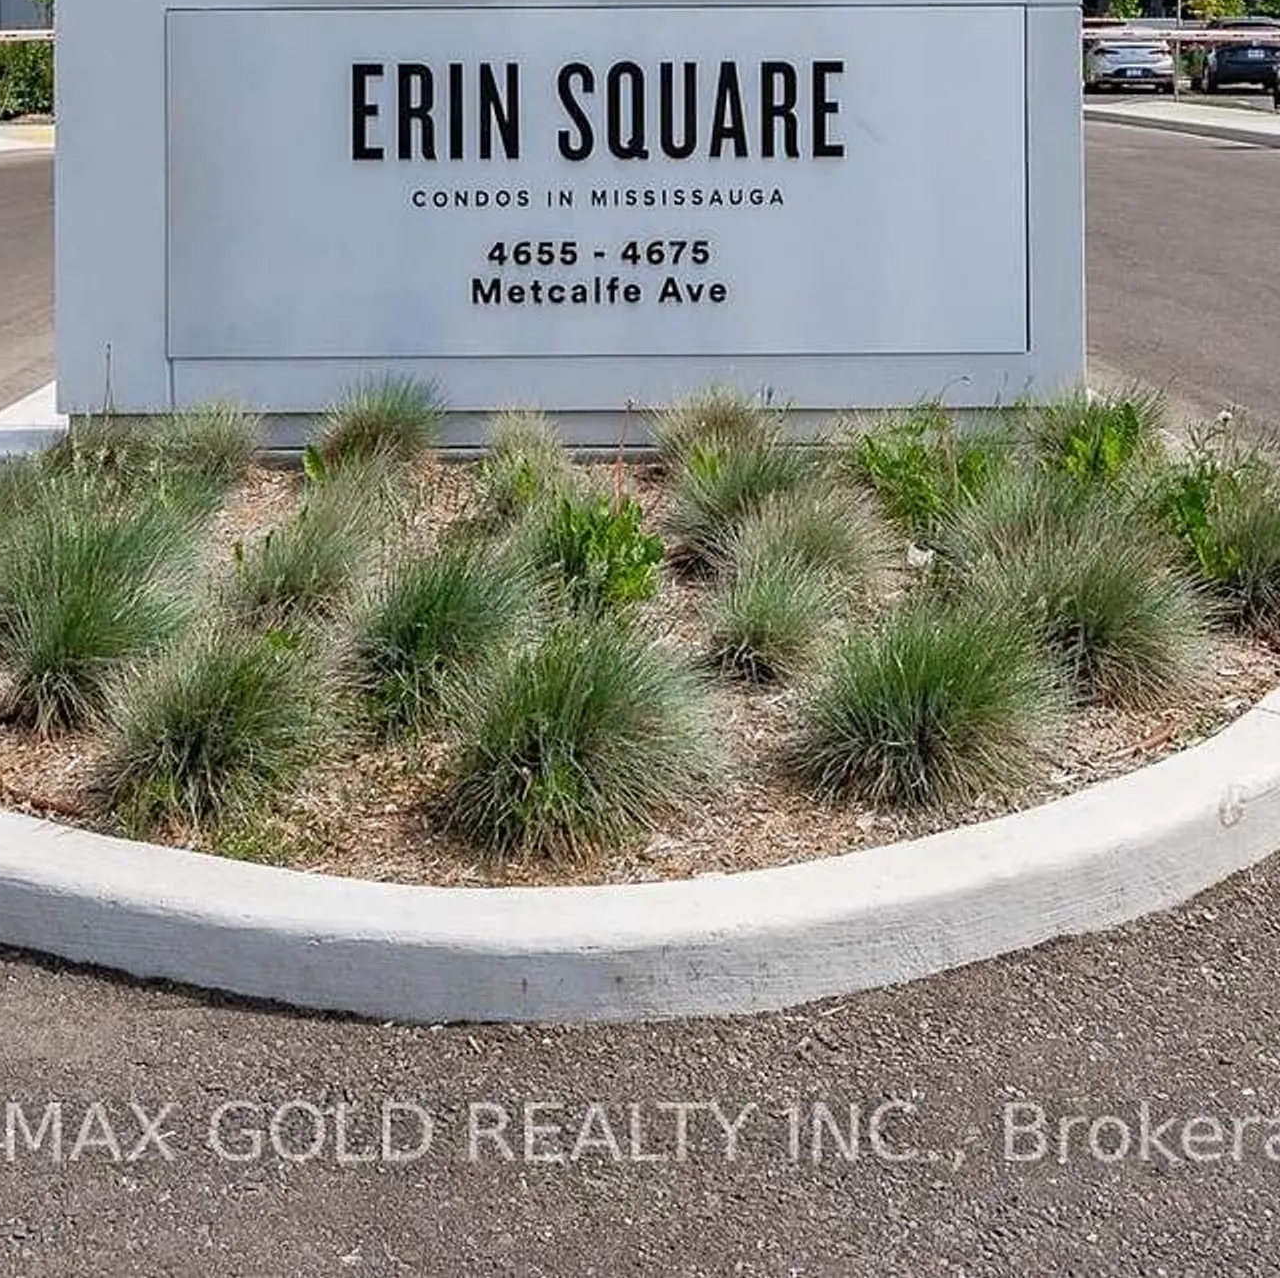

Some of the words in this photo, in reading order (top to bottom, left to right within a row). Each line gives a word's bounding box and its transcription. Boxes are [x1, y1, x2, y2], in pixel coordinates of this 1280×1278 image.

[351, 62, 520, 161] ERIN
[557, 60, 846, 162] SQUARE
[412, 190, 530, 208] CONDOS
[547, 190, 574, 208] IN
[591, 189, 785, 207] MISSISSAUGA
[487, 240, 578, 267] 4655
[620, 240, 711, 266] 4675
[472, 276, 641, 305] Metcalfe
[657, 276, 728, 304] Ave
